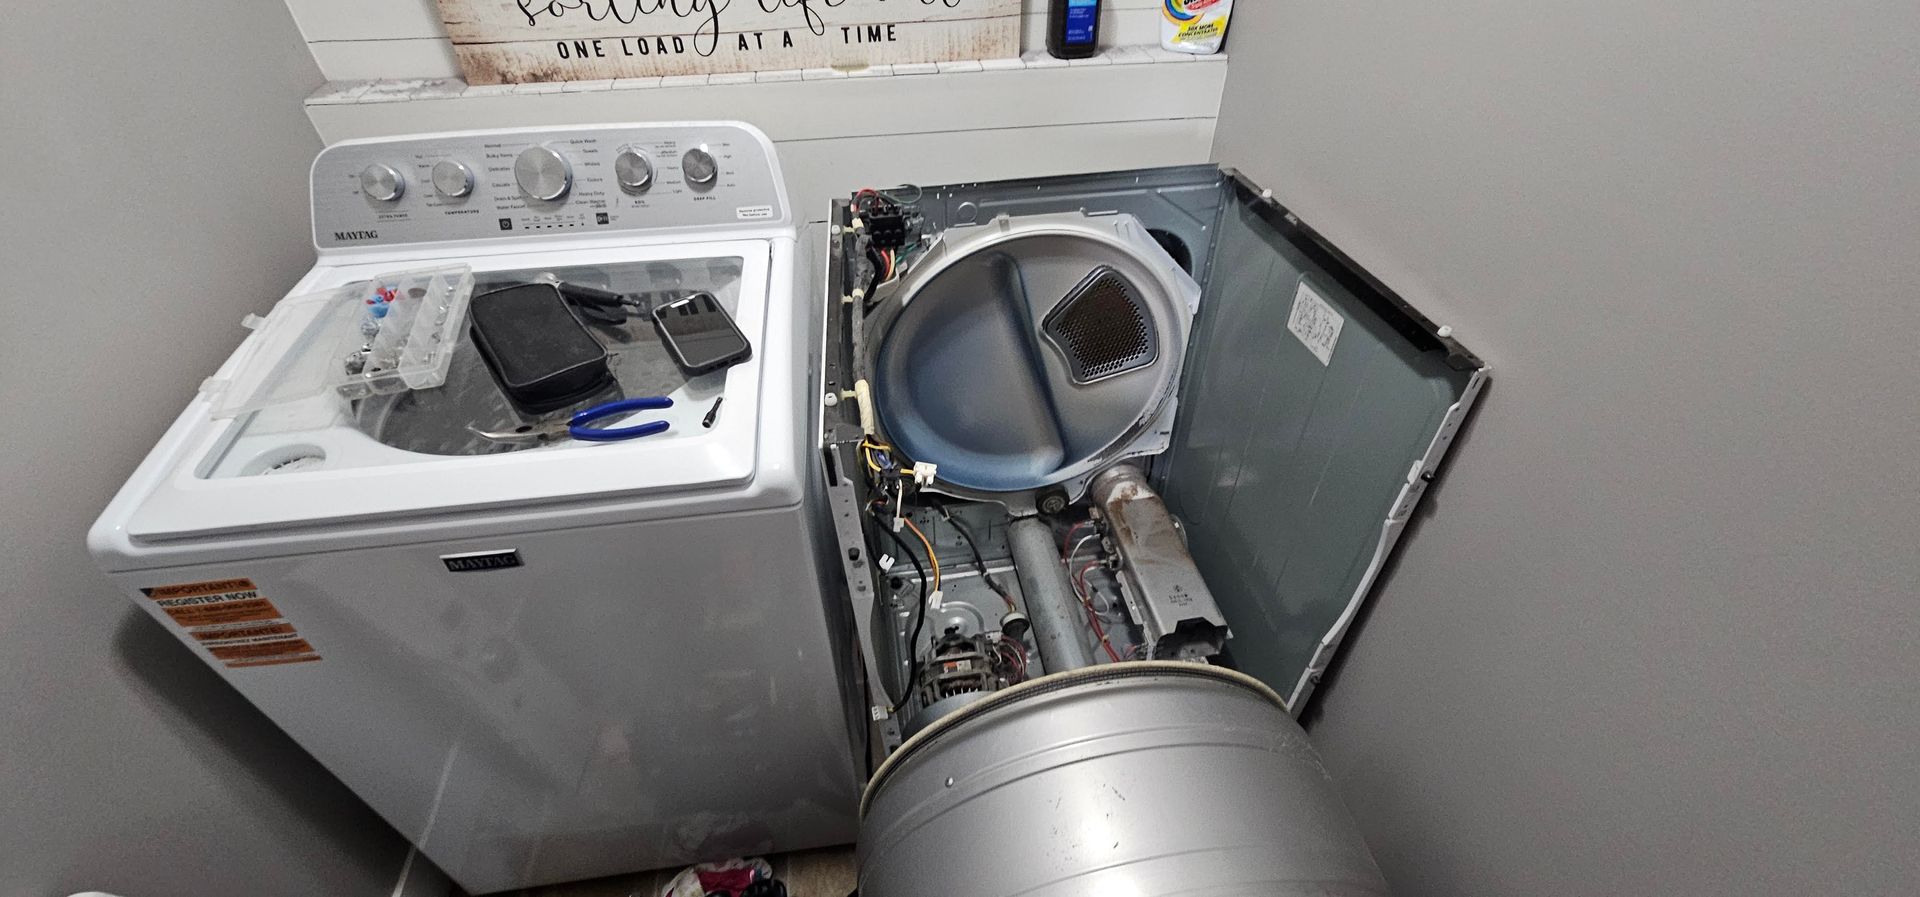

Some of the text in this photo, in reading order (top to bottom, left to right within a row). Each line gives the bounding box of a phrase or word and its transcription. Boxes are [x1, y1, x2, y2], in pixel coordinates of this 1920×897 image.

[557, 24, 897, 59] ONE LOAD AT A TIME
[334, 230, 379, 241] MAYTAG
[448, 555, 516, 570] MAYTAG
[157, 594, 224, 607] REGISTER
[225, 590, 257, 601] NOW
